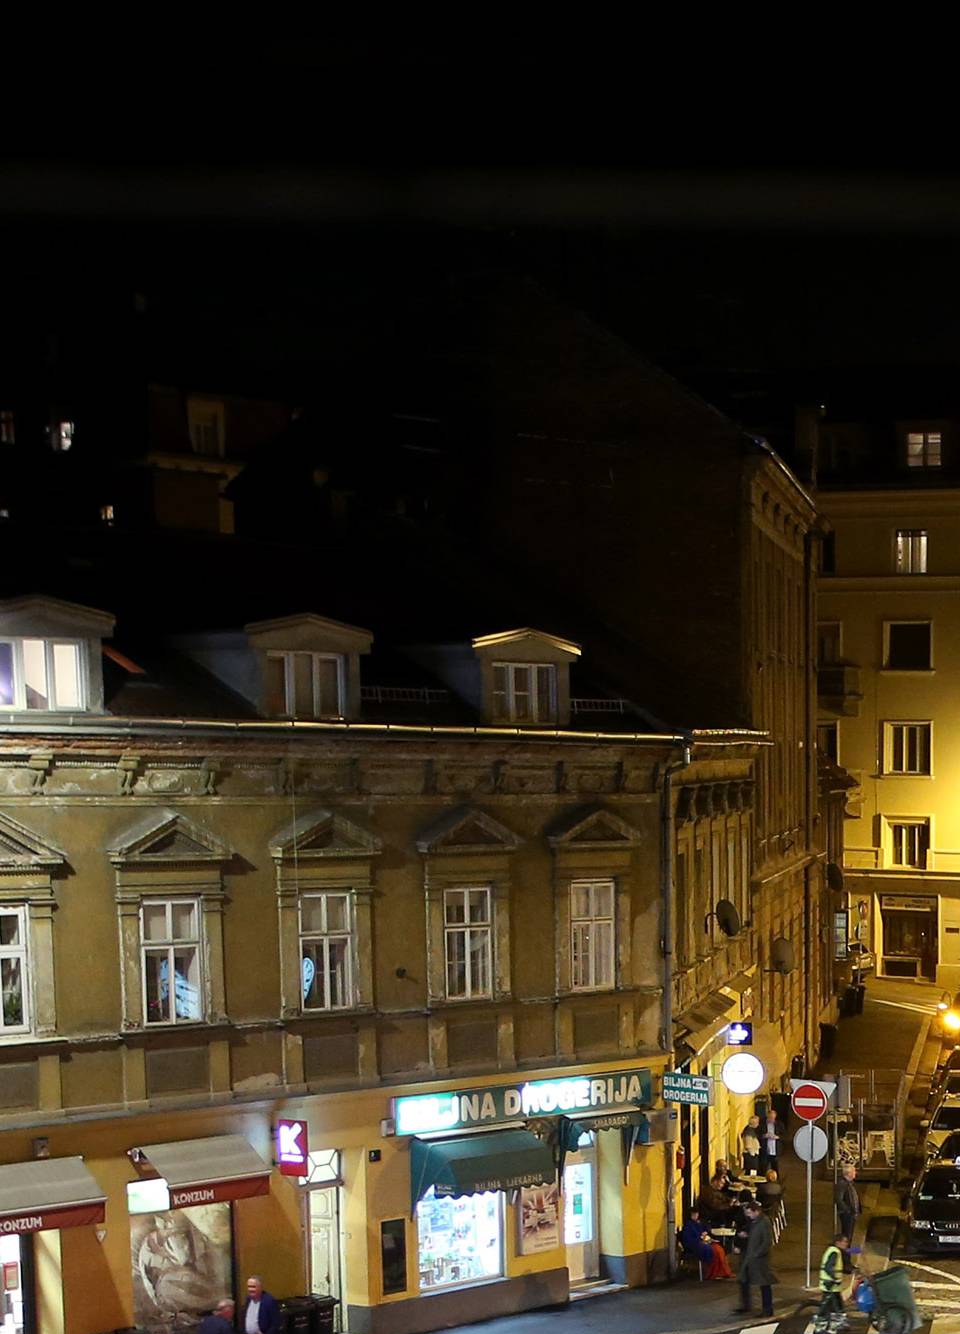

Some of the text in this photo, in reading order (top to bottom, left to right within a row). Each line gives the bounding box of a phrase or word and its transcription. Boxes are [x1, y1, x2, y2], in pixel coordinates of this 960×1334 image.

[663, 1076, 691, 1089] BILJNA
[399, 1075, 642, 1131] LJNA DROGERIJA
[663, 1089, 708, 1103] DROGERIJA
[280, 1122, 302, 1154] K
[173, 1189, 214, 1206] KONZUM
